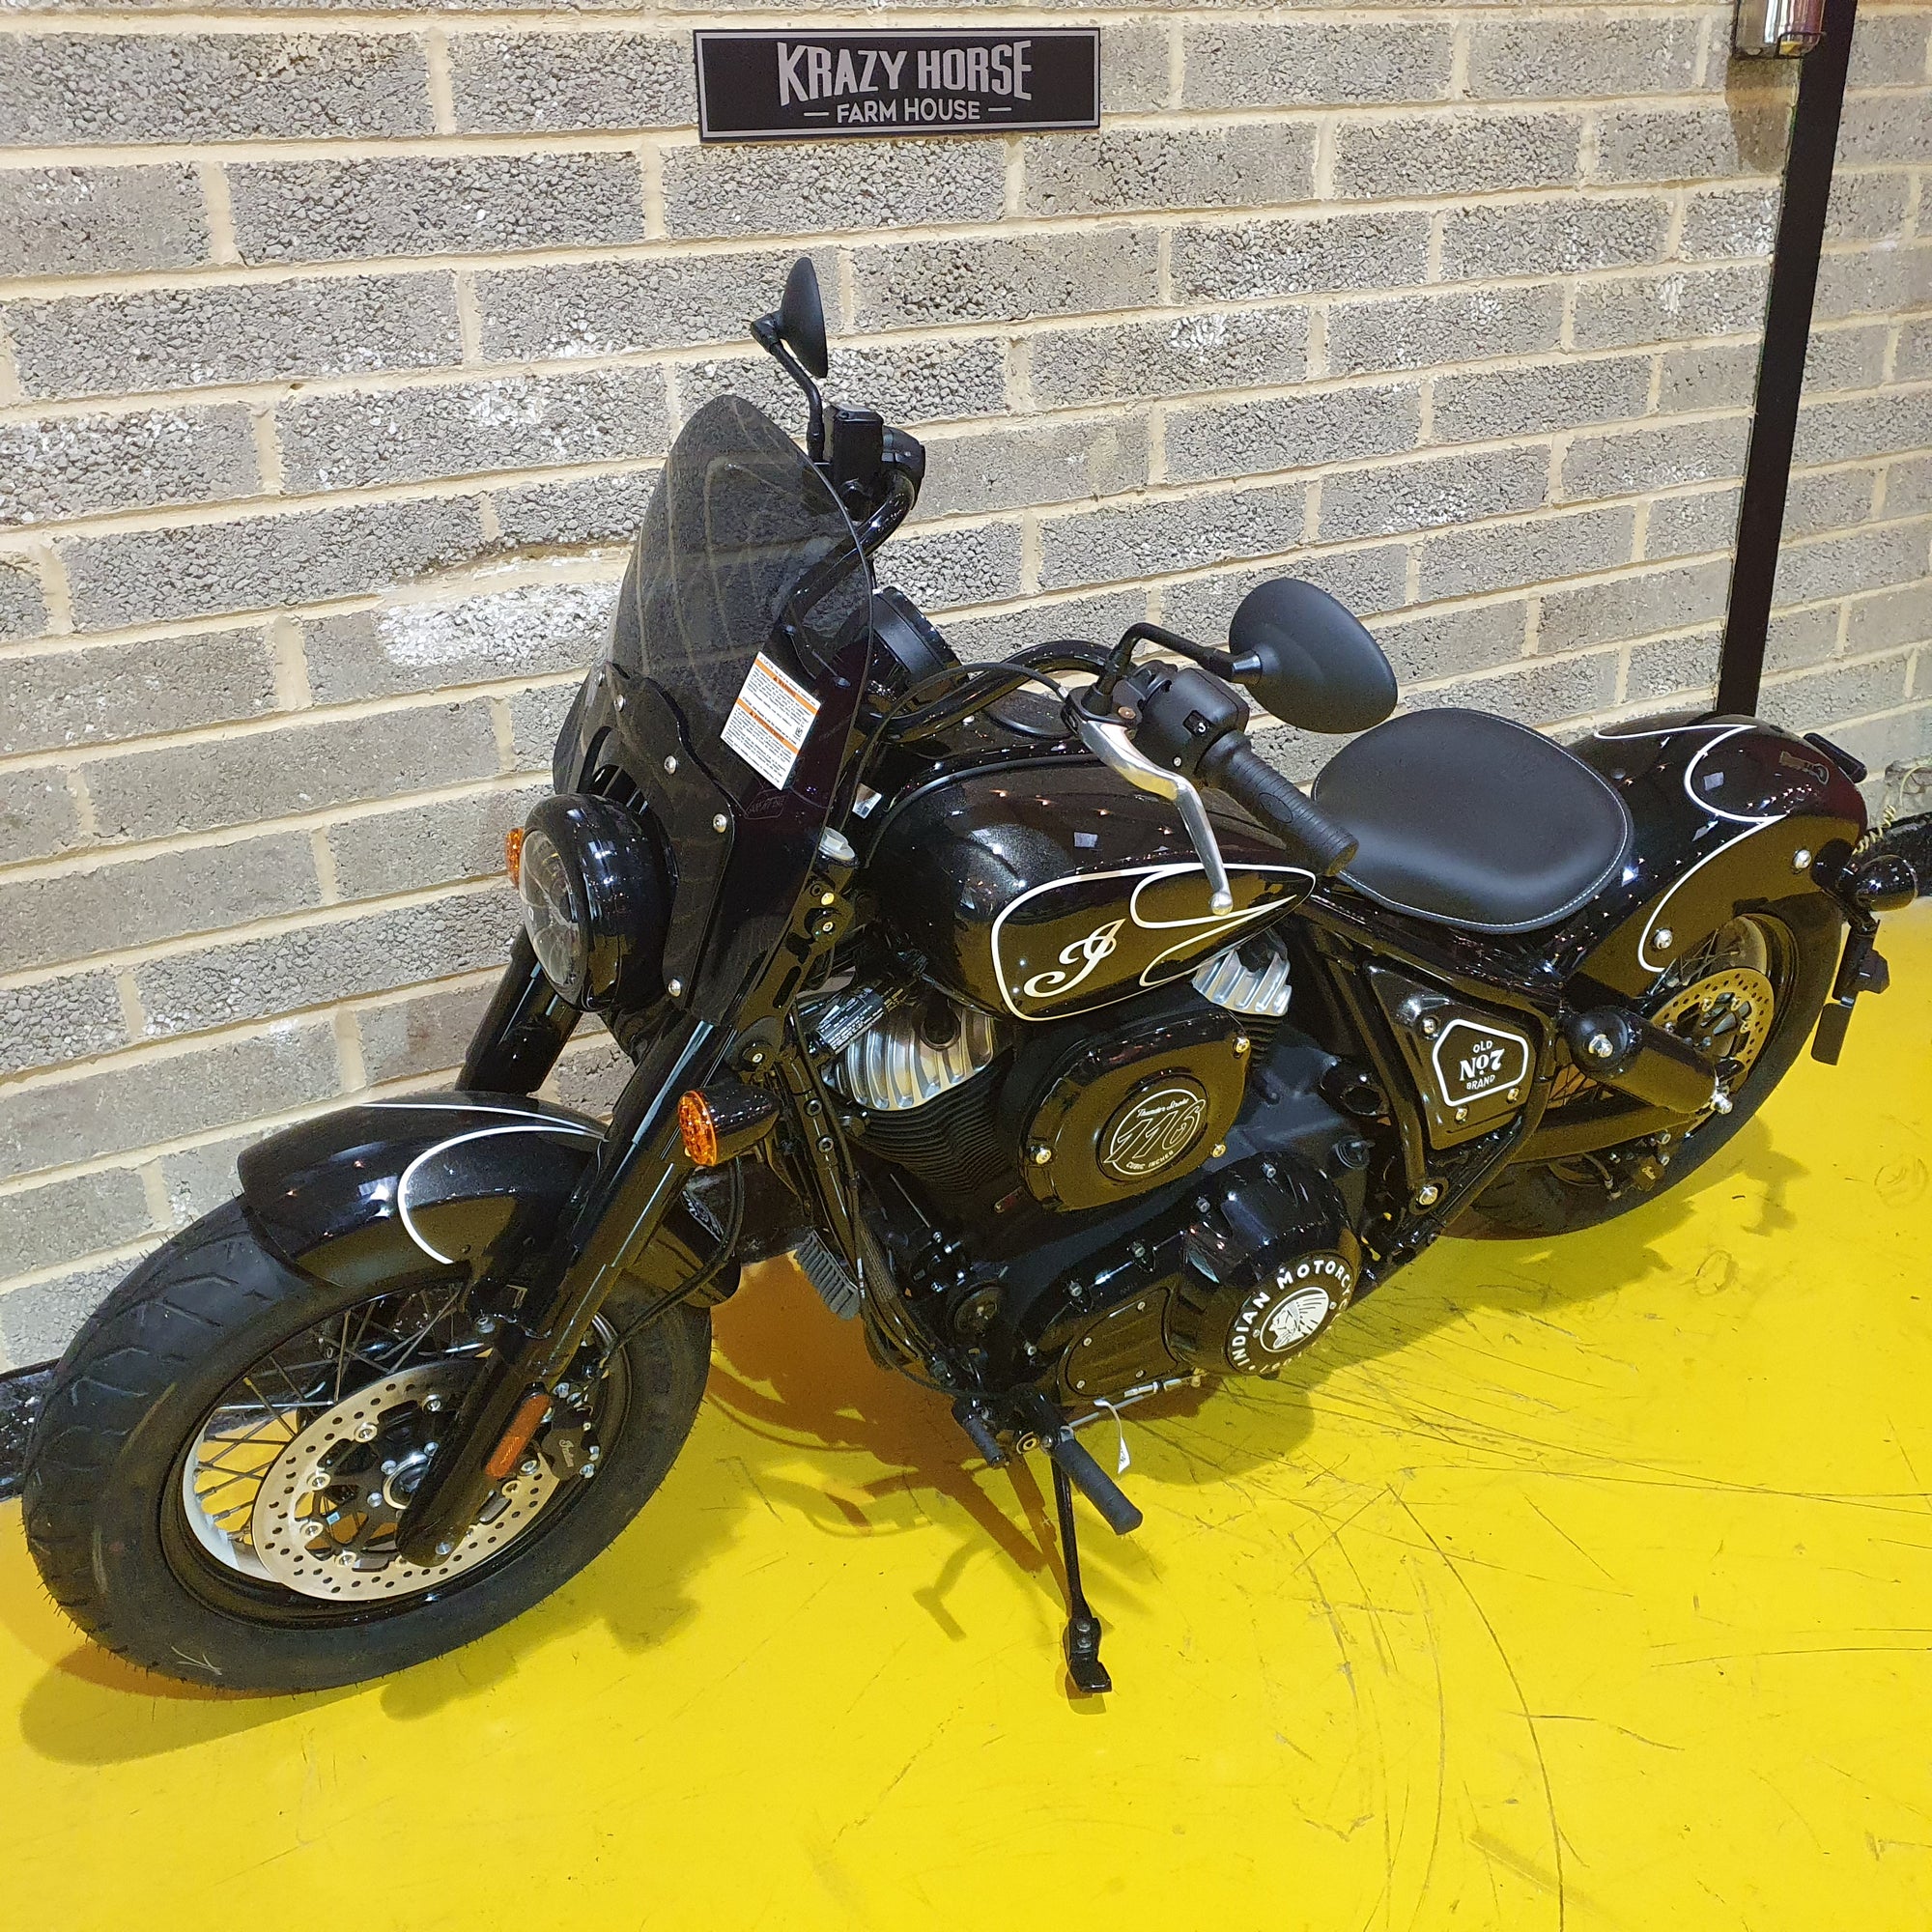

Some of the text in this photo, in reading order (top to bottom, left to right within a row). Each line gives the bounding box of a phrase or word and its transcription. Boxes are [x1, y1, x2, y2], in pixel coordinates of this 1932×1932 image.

[777, 40, 1032, 106] KRAZY HORSE
[837, 98, 980, 124] FARM HOUSE
[1472, 1040, 1492, 1053] OLD
[1466, 1074, 1495, 1090] BRAND
[1102, 1099, 1207, 1163] 116
[1232, 1292, 1271, 1367] INDIAN
